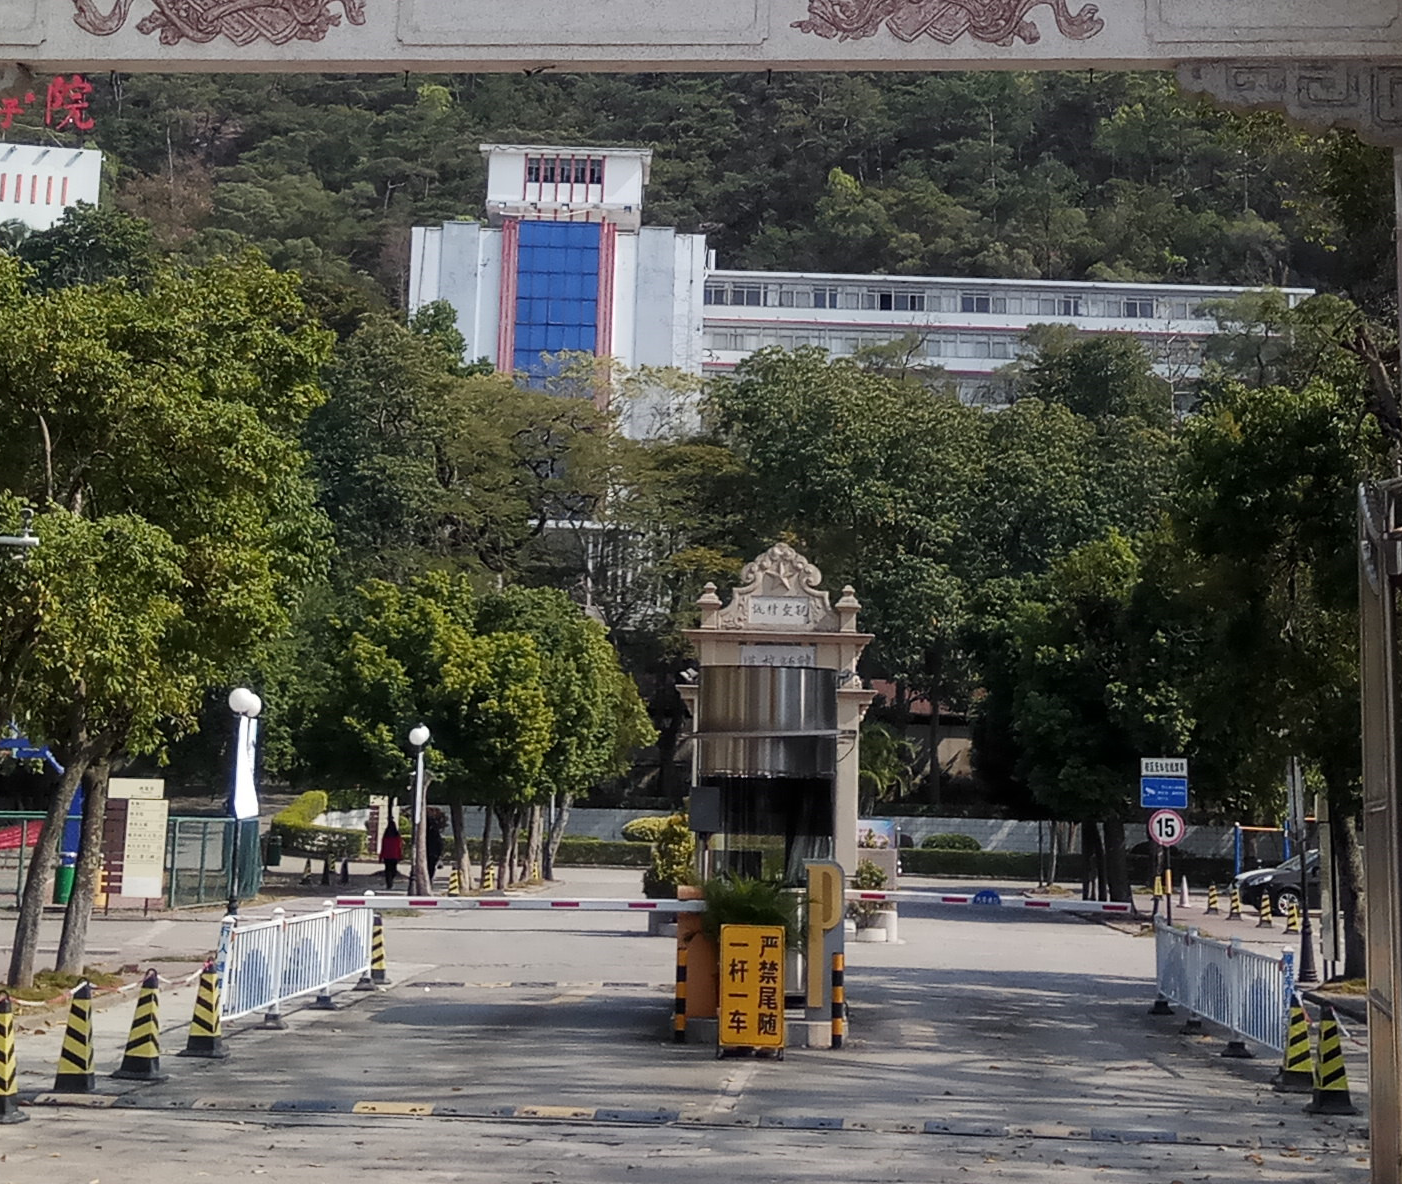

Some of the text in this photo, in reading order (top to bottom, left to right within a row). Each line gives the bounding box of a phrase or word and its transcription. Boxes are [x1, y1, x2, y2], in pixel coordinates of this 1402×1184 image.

[1156, 817, 1175, 838] 15
[727, 941, 750, 1035] 一杆一车
[757, 935, 780, 1036] 严禁尾随
